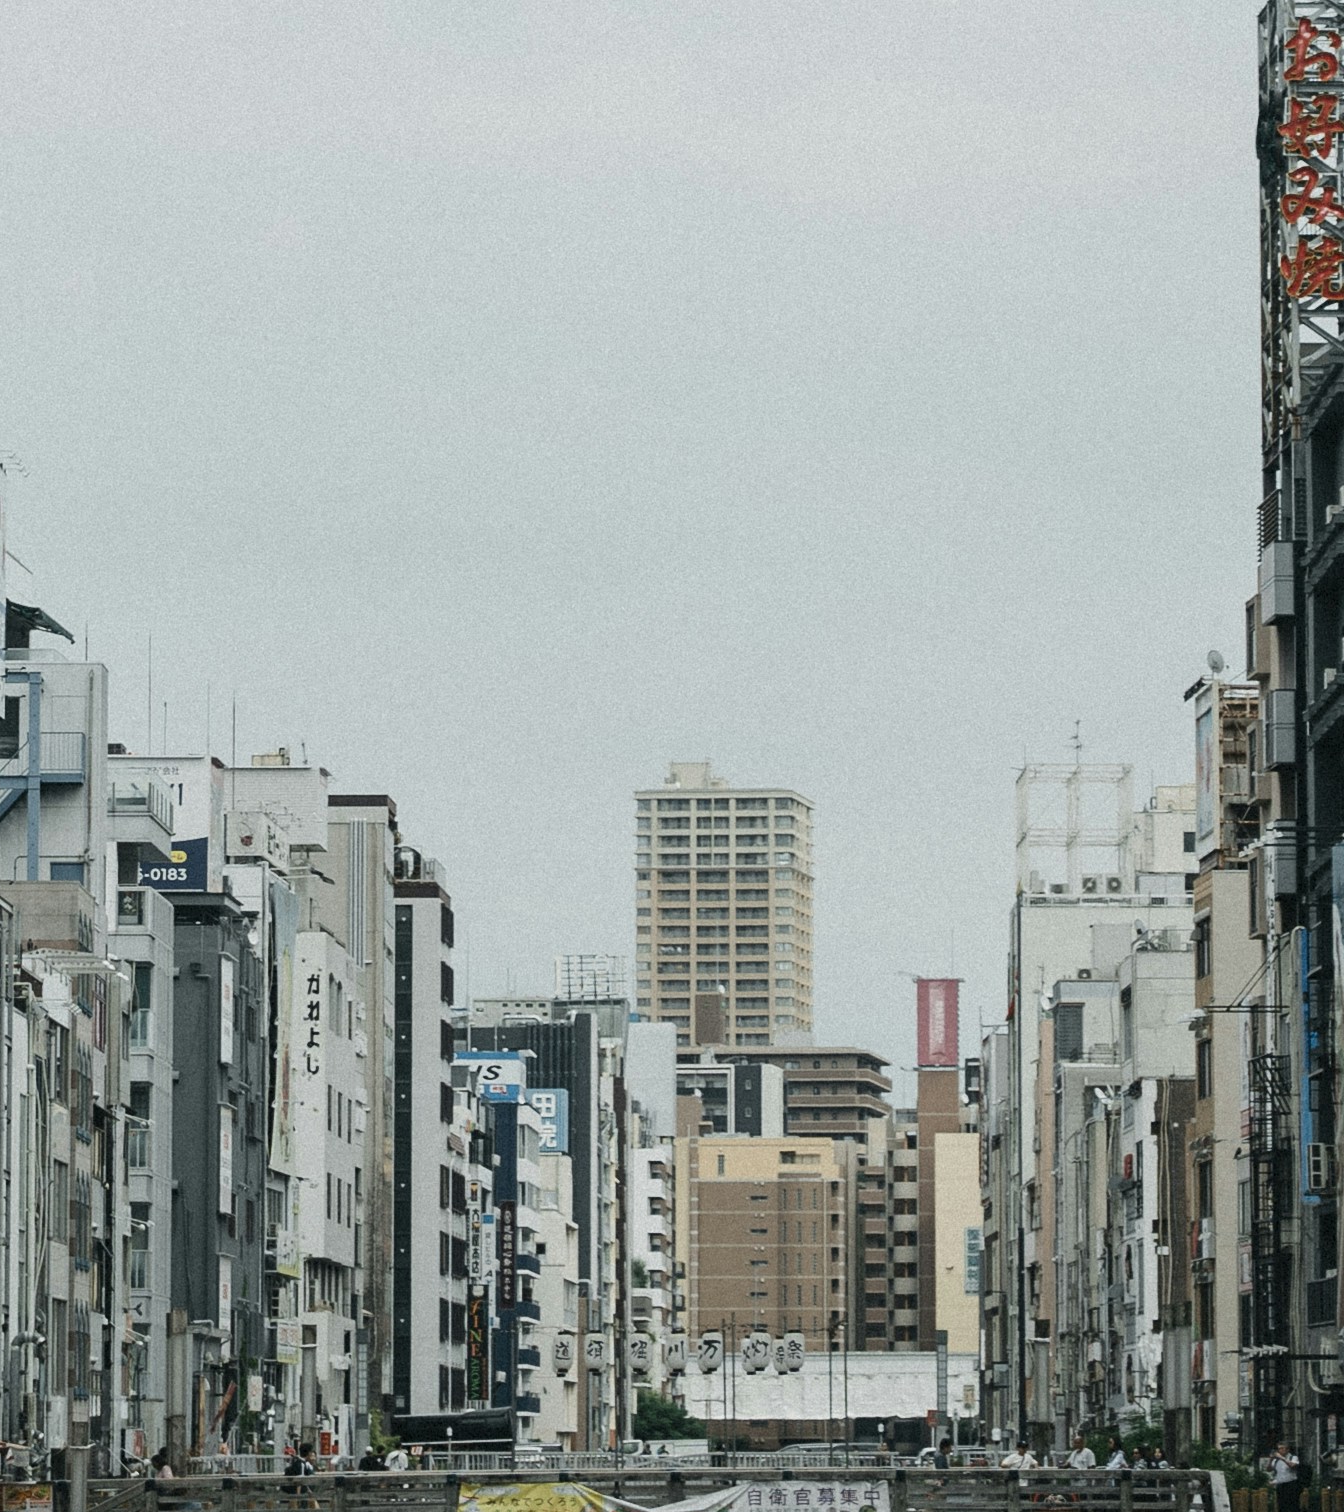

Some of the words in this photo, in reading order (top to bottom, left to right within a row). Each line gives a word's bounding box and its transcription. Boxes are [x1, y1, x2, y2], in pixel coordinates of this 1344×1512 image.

[485, 1496, 579, 1507] みんなでつくろう
[747, 1487, 881, 1507] 自衛官募集中
